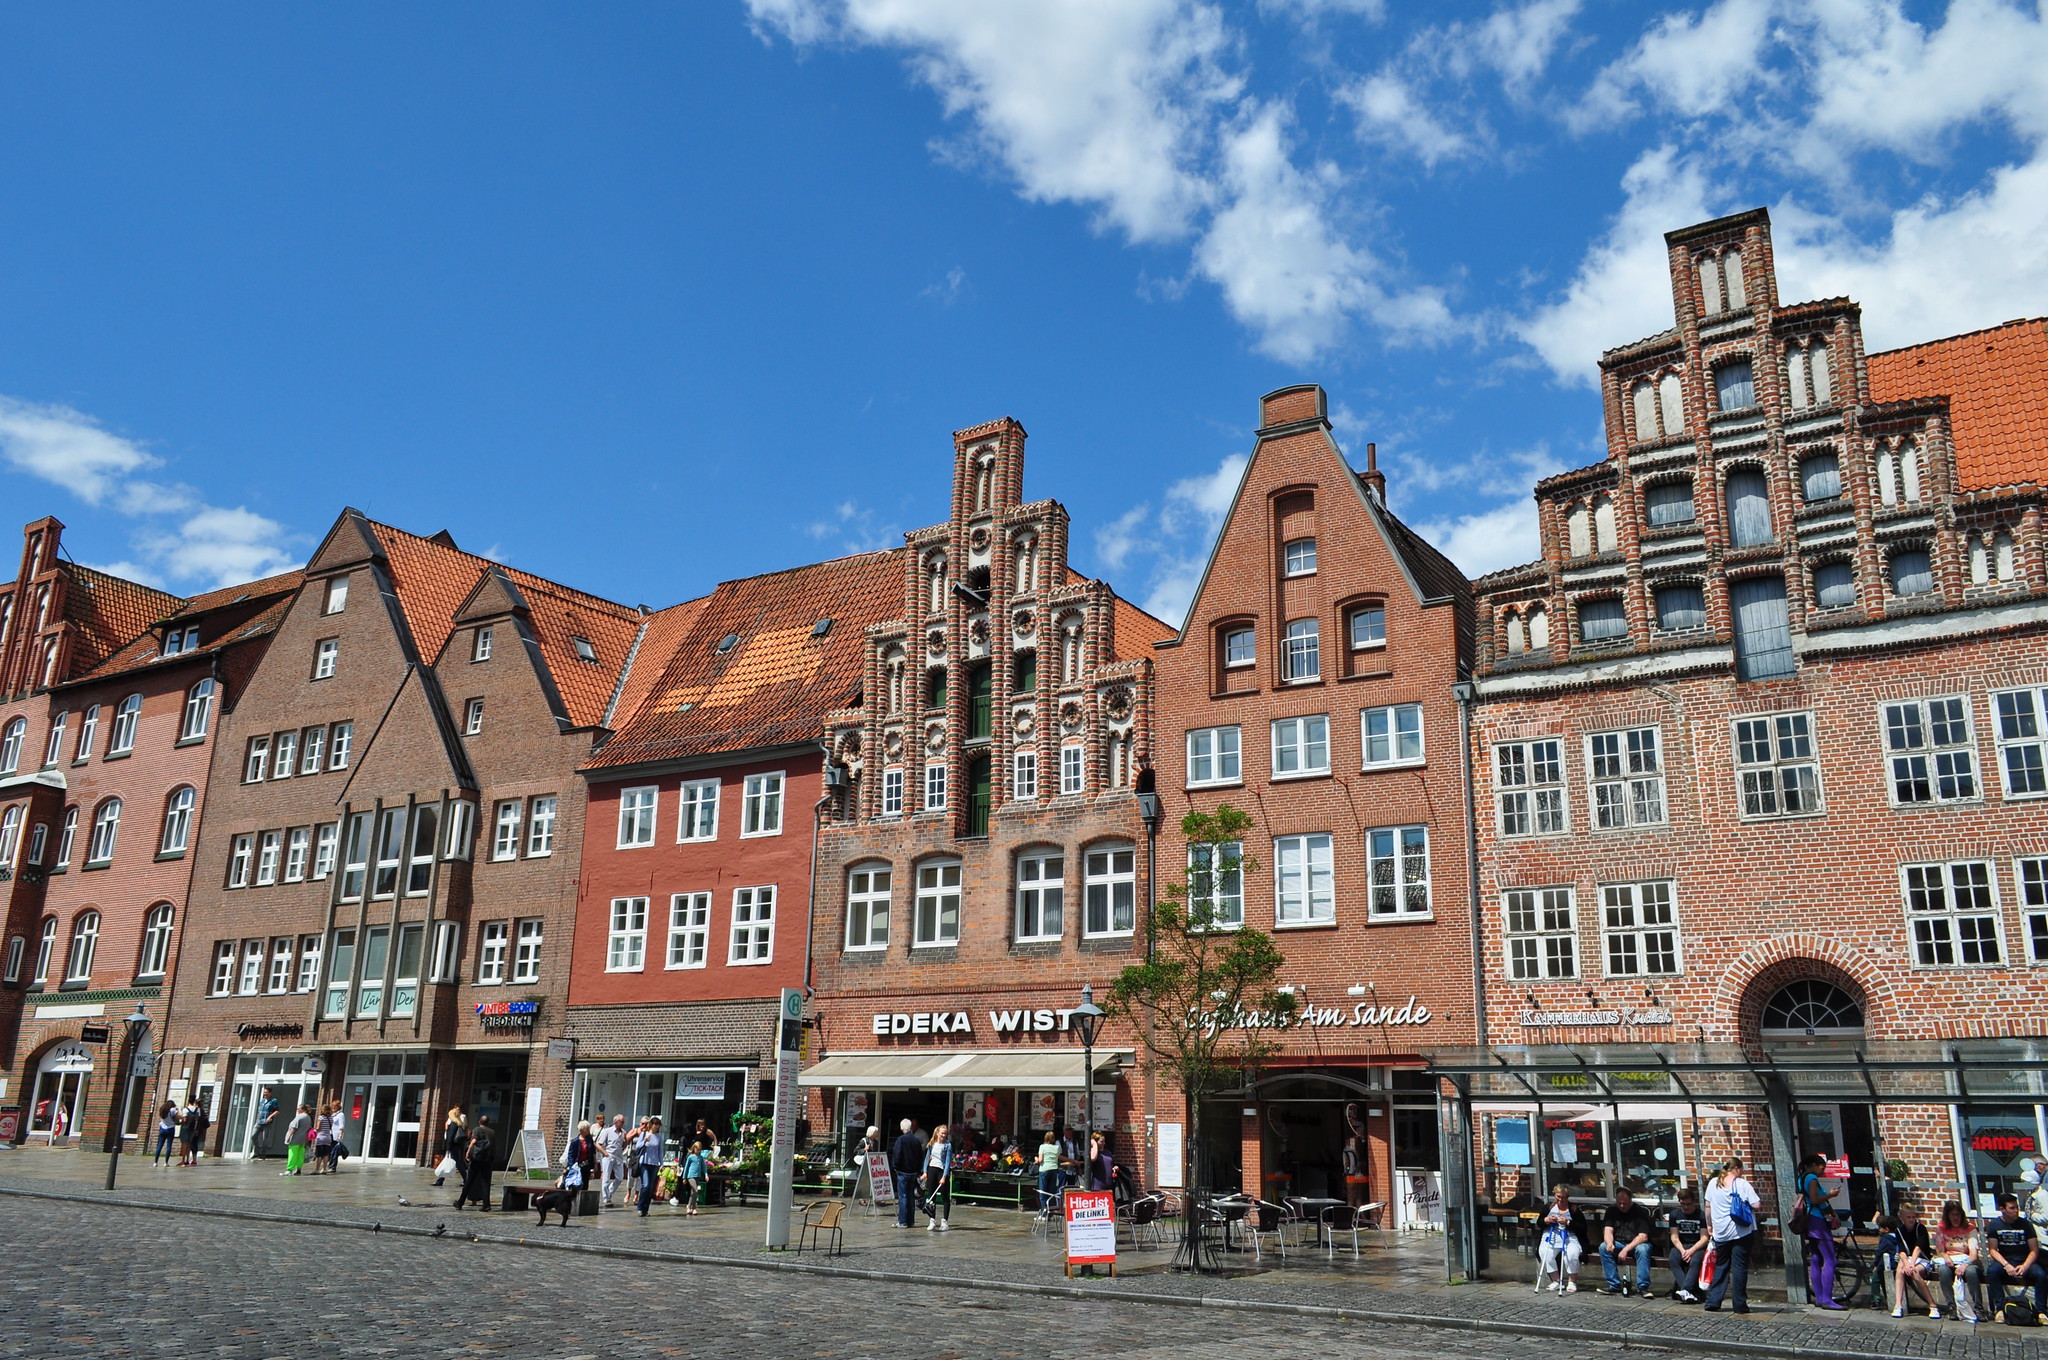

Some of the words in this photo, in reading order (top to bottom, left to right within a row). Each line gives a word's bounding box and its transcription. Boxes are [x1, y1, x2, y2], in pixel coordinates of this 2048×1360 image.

[484, 1002, 538, 1014] INTERSPORT
[792, 999, 799, 1011] H
[1297, 1004, 1346, 1027] Am
[1350, 995, 1432, 1027] Sande
[481, 1015, 531, 1027] FRIEDRICH
[872, 1011, 972, 1035] EDEKA
[989, 1009, 1076, 1032] WIST
[1520, 1009, 1619, 1026] KAFFEEHAUS
[687, 1074, 725, 1083] Uhrenservice
[1551, 1075, 1588, 1087] HAUS
[1070, 1197, 1094, 1209] Hier
[1094, 1197, 1109, 1208] ist
[1075, 1210, 1086, 1219] DIE
